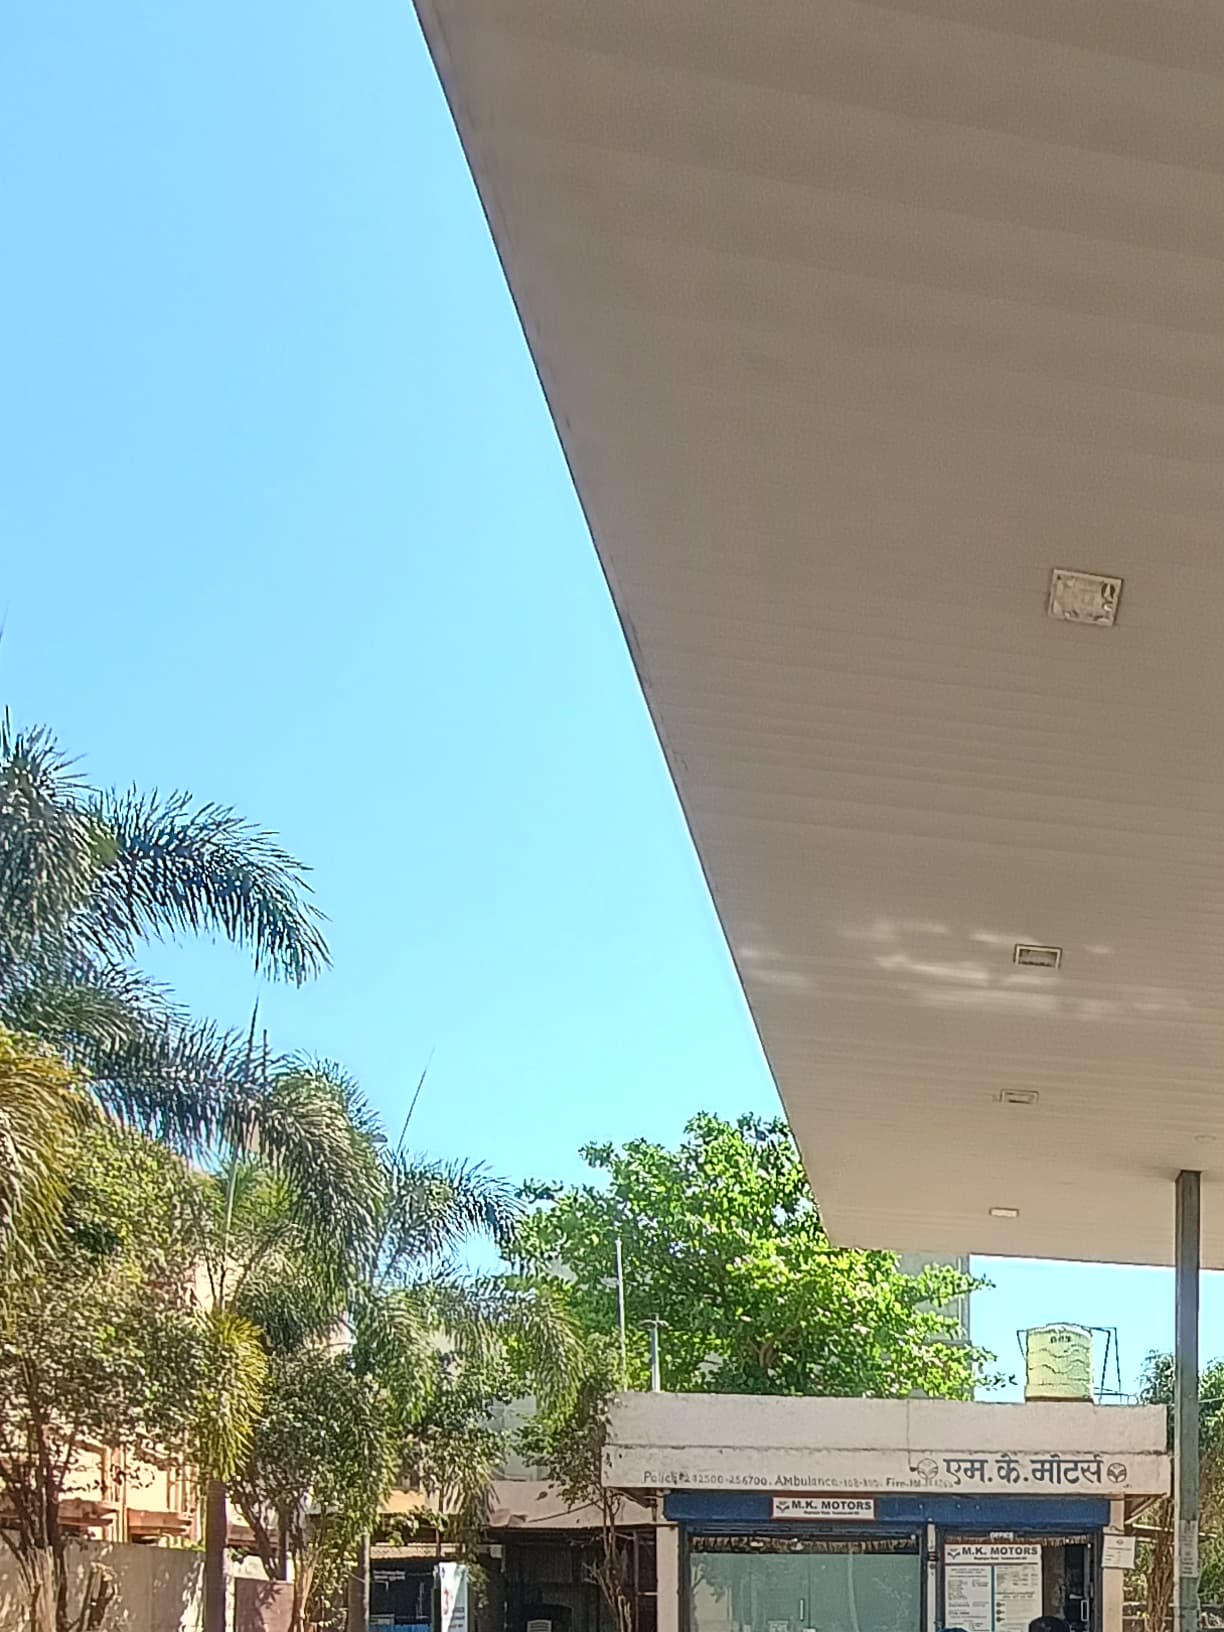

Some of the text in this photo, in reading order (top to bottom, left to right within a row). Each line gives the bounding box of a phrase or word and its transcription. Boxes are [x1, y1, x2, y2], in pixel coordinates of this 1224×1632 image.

[791, 1500, 872, 1511] M.K. MOTORS
[961, 1546, 1038, 1556] M.K. MOTORS
